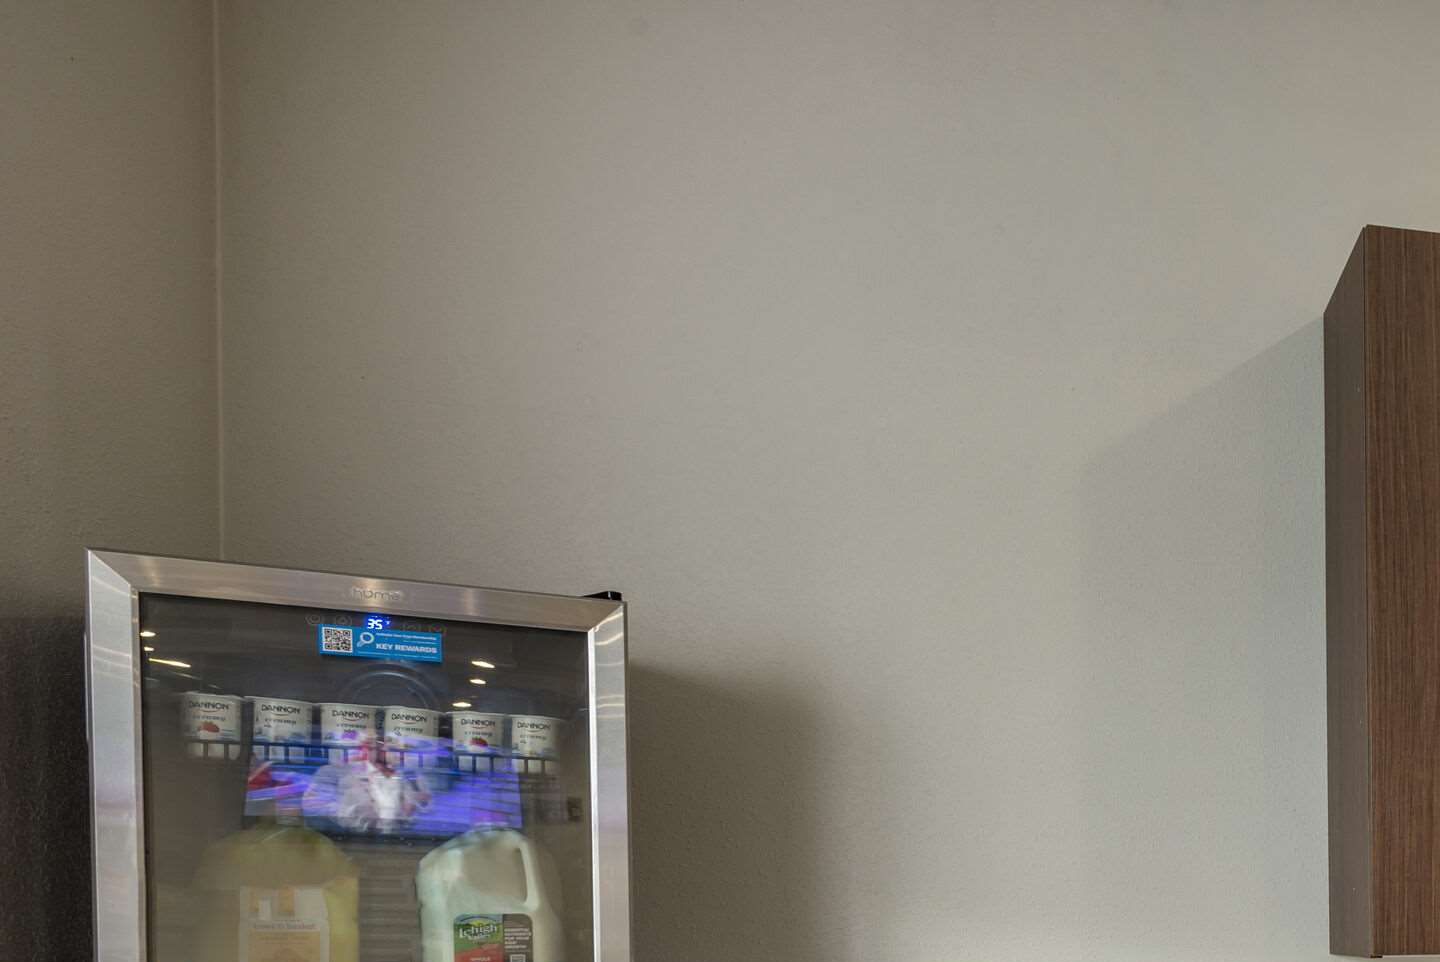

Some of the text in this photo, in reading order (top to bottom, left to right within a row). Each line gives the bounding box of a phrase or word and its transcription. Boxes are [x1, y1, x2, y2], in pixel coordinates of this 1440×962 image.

[367, 618, 383, 630] 35
[376, 642, 393, 651] KEY
[394, 643, 438, 654] REWARDS
[261, 704, 300, 714] DANNON
[332, 710, 369, 719] DANNON
[391, 713, 427, 722] DANNON
[461, 718, 496, 728] DANNON
[517, 721, 551, 731] DANNON
[459, 924, 497, 938] Lehigh
